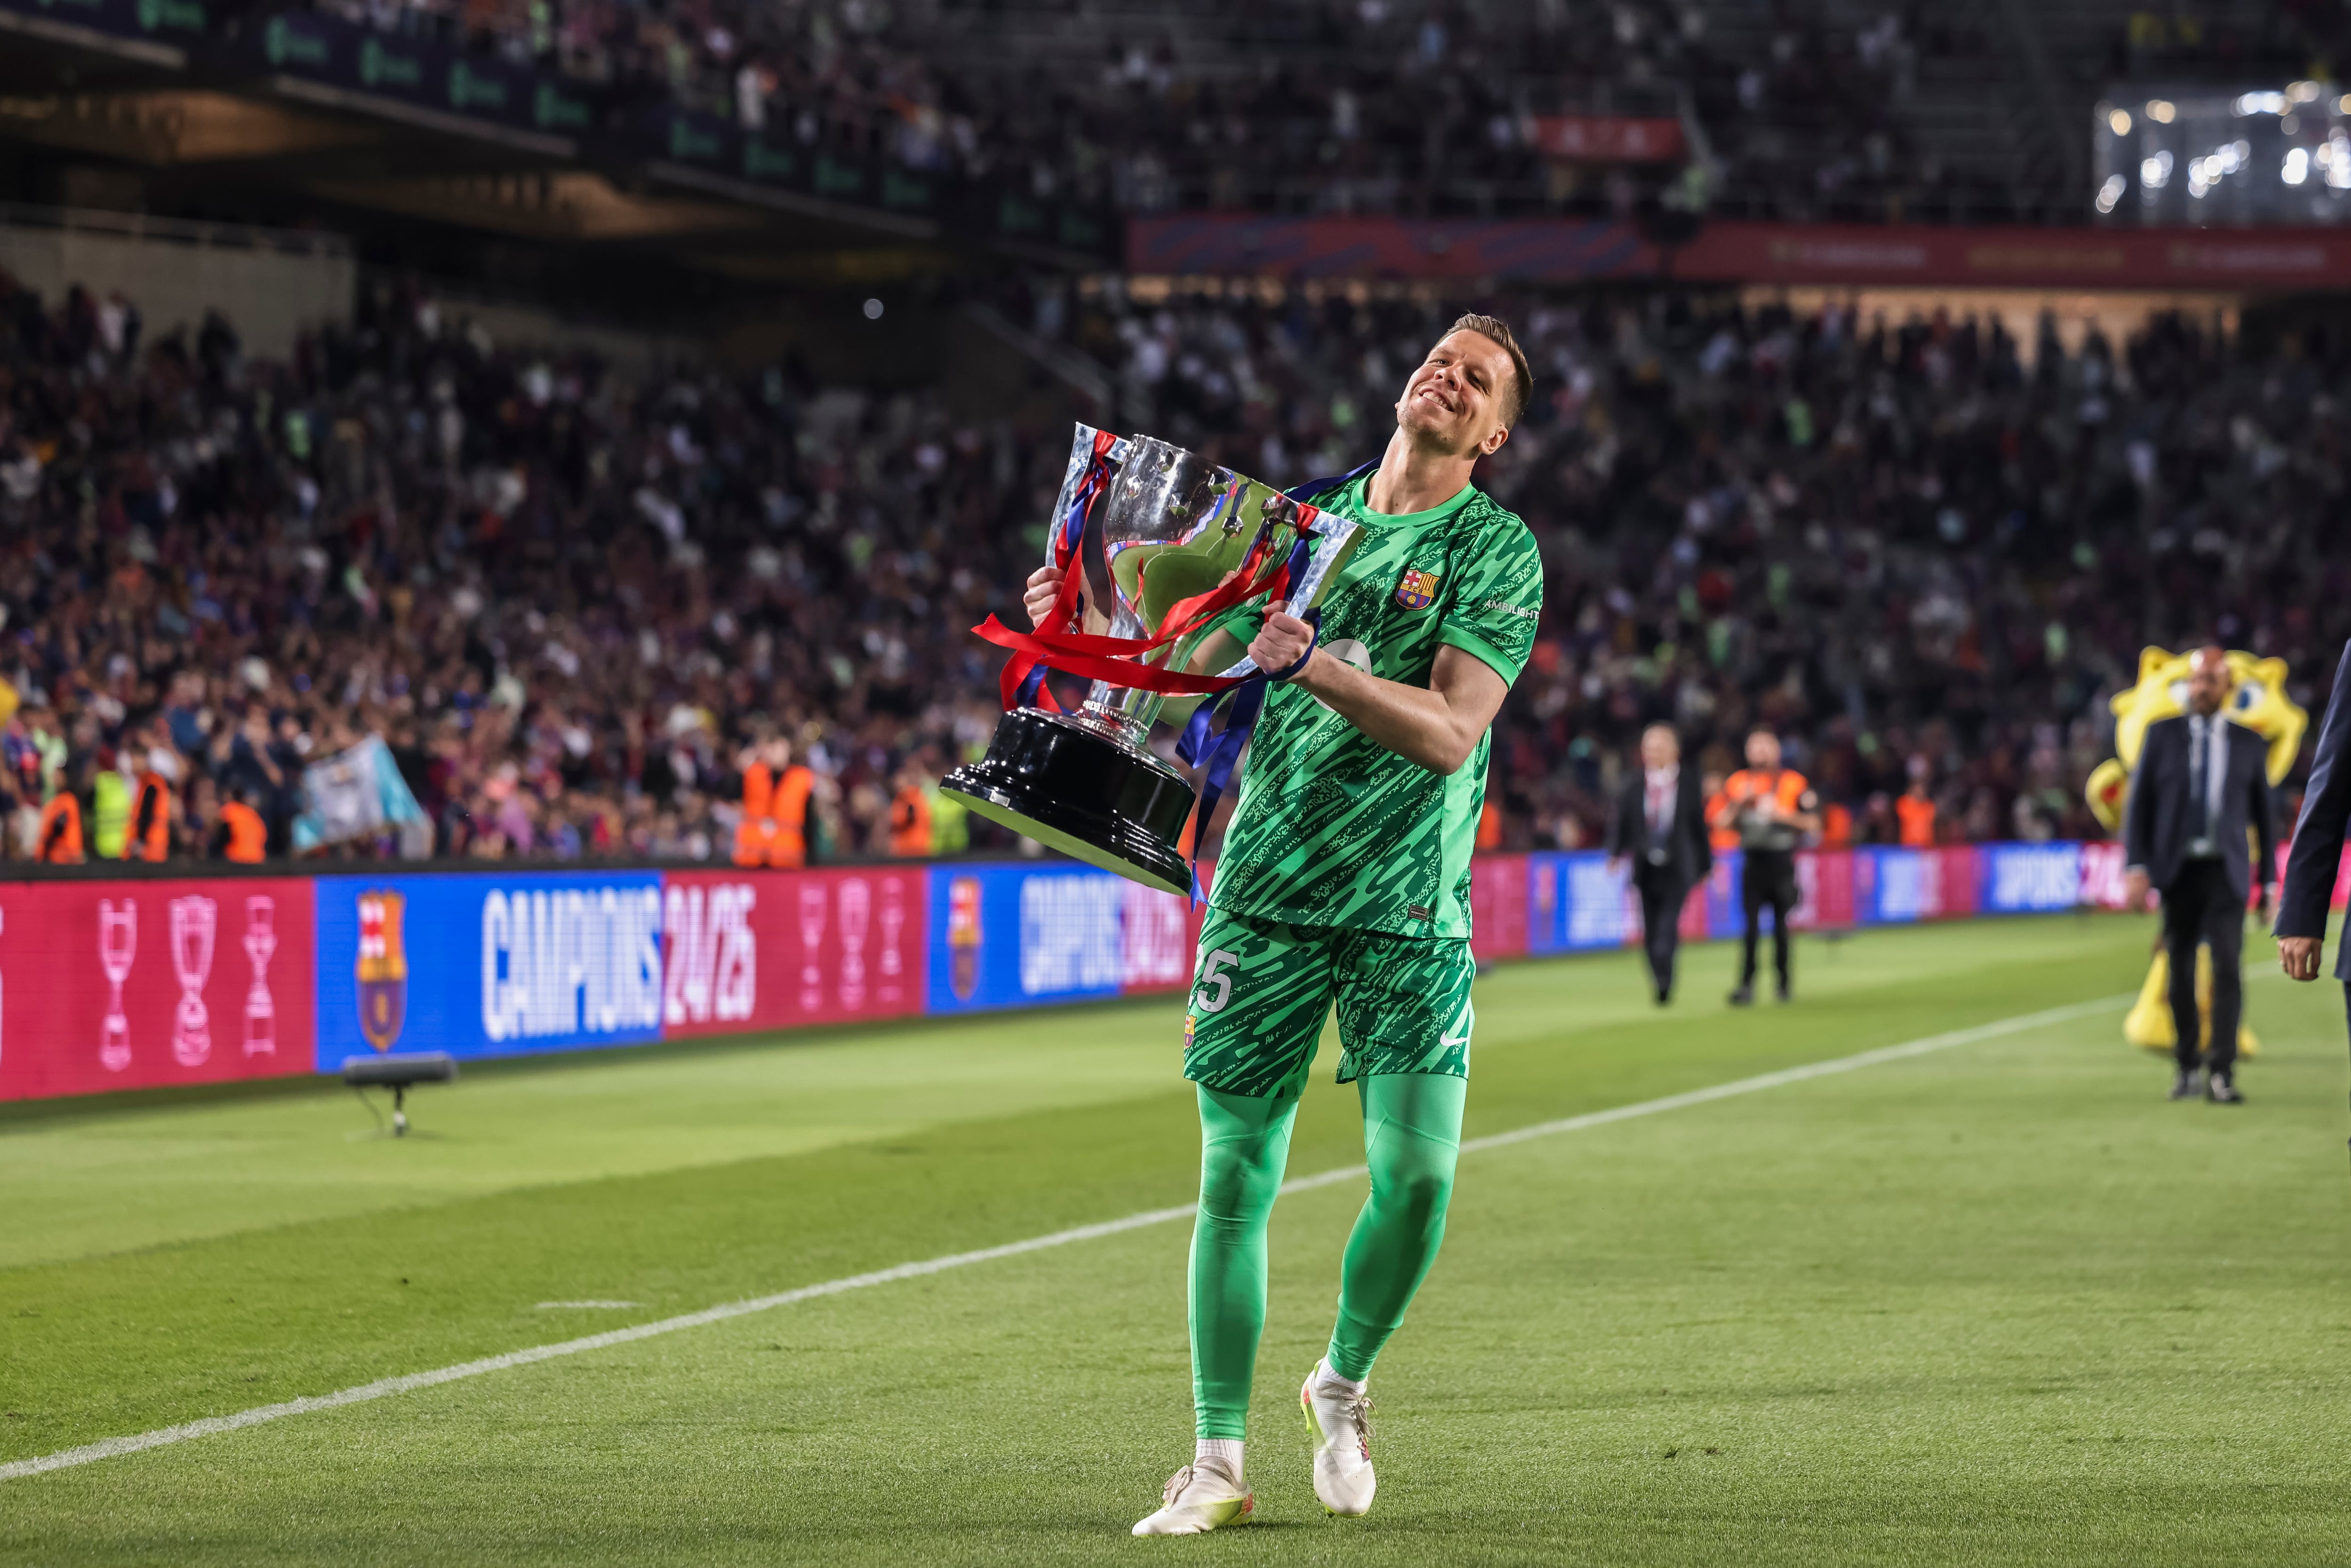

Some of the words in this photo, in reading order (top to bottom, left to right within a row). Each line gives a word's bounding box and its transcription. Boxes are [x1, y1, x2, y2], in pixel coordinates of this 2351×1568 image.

[1484, 599, 1539, 620] AMBILIGHT
[481, 887, 662, 1042] CAMPIONS
[663, 883, 757, 1025] 24/25
